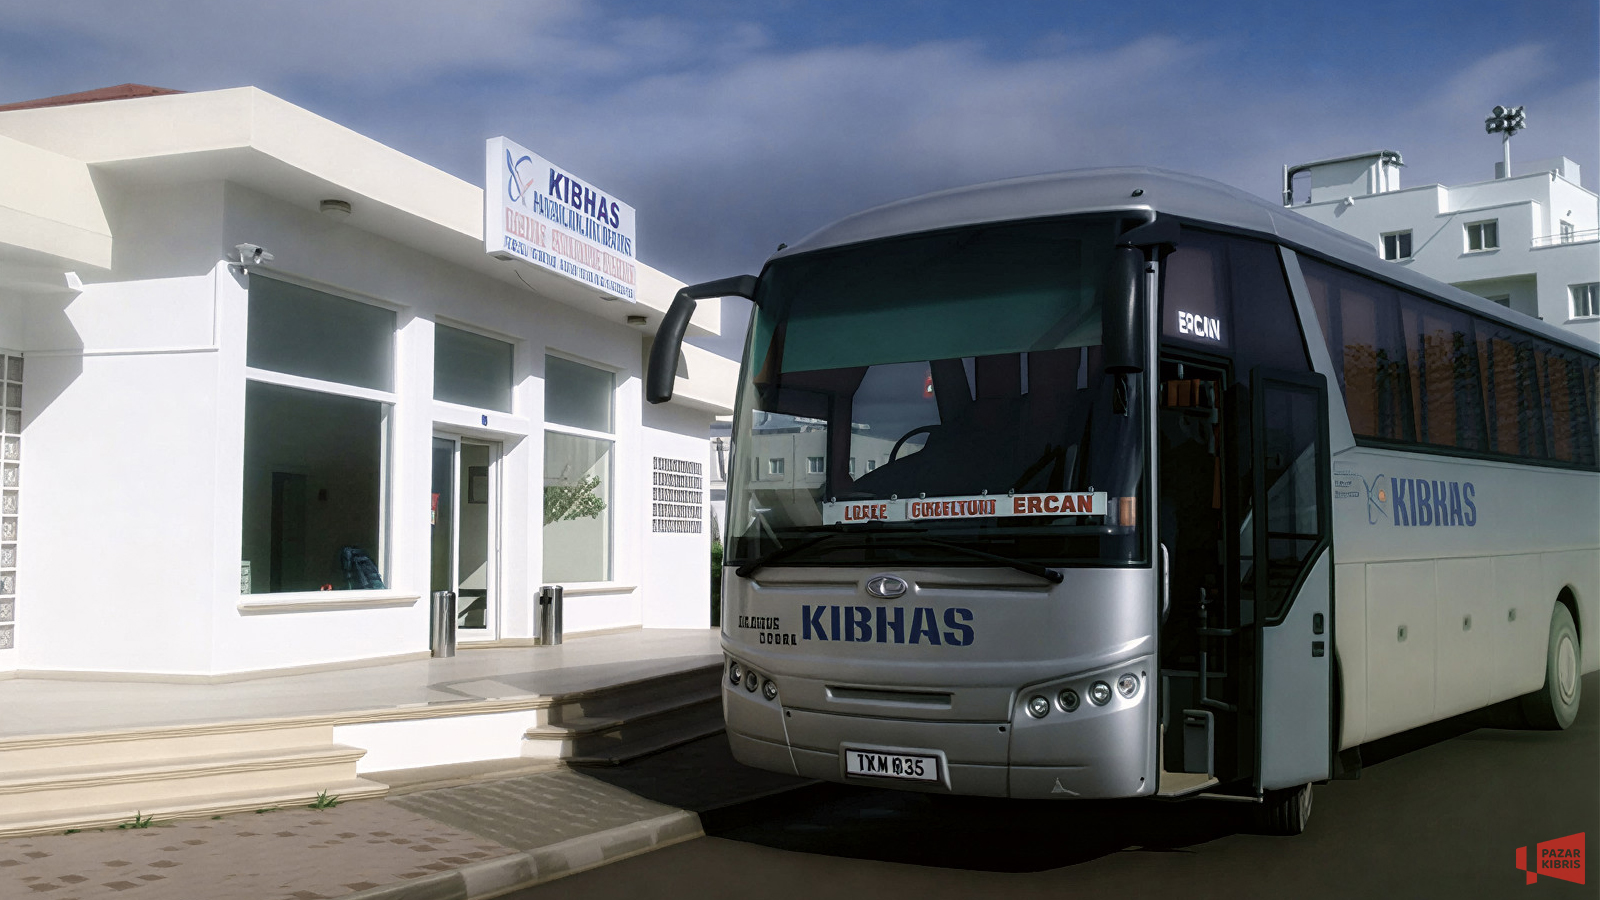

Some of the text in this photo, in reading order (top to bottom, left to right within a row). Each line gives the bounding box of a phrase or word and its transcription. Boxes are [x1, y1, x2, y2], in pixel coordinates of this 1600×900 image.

[549, 167, 620, 229] KIBHAS
[1013, 494, 1093, 514] ERCAN
[802, 605, 975, 647] KIBHAS
